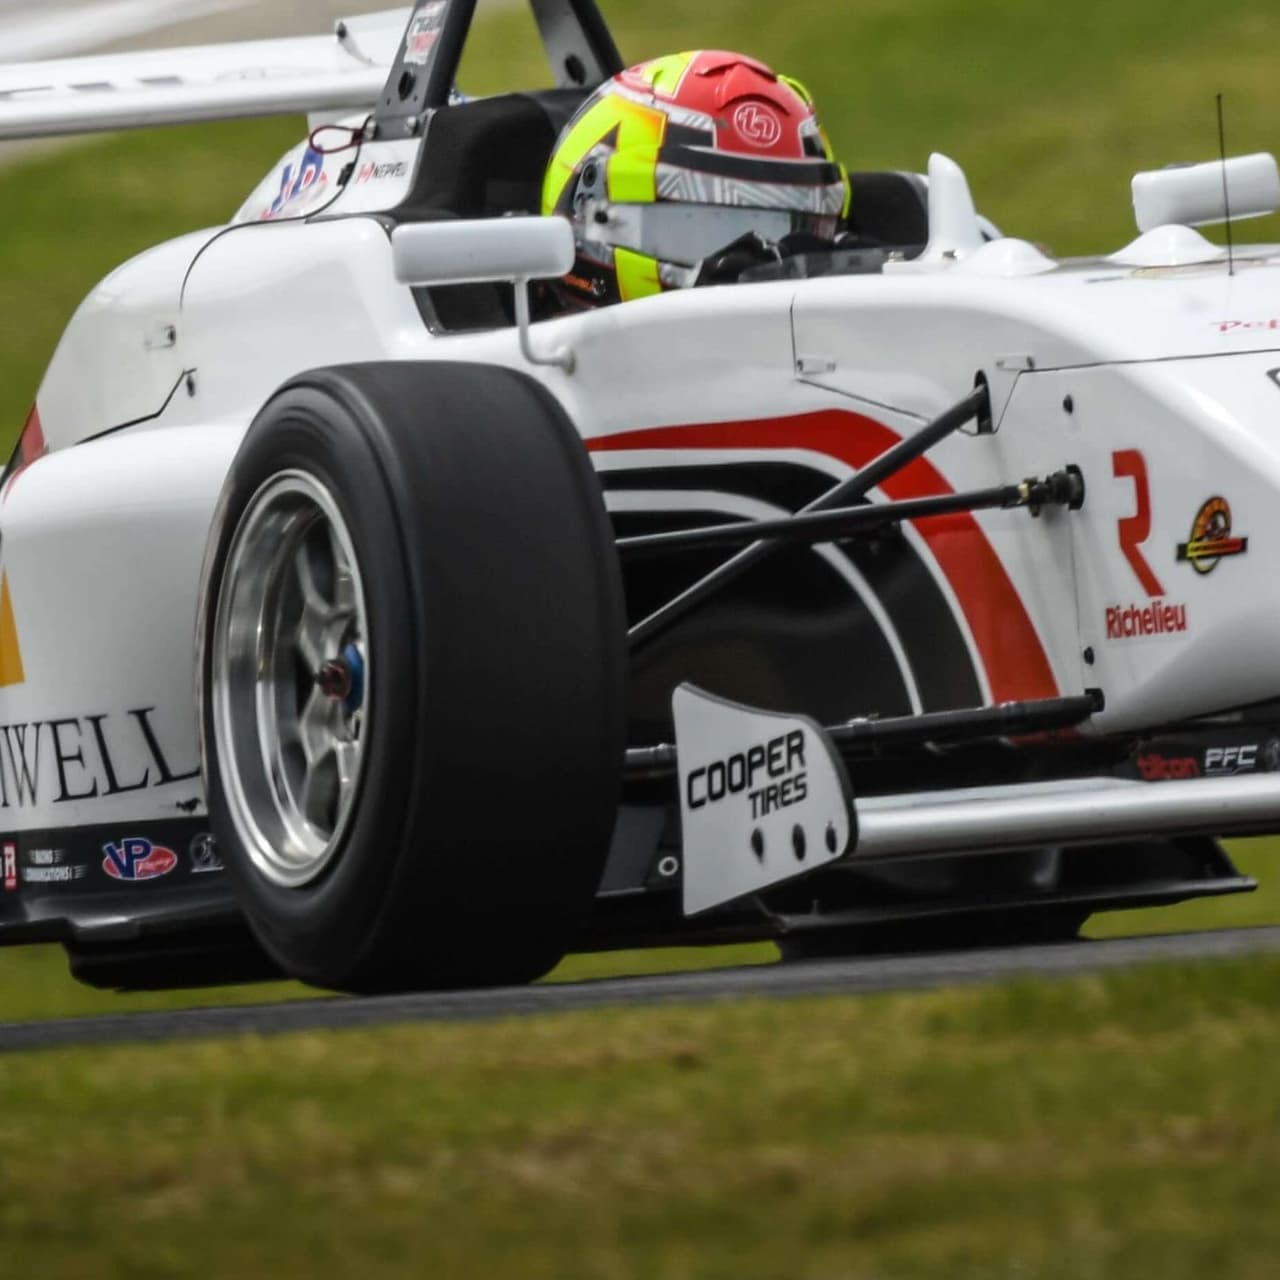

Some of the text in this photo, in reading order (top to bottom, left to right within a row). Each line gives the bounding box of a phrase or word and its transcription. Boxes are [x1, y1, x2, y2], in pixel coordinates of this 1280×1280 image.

[1105, 600, 1187, 639] Richelieu
[687, 729, 806, 810] COOPER
[1205, 745, 1258, 768] PFC
[748, 773, 807, 820] TIRES
[102, 837, 153, 880] VP
